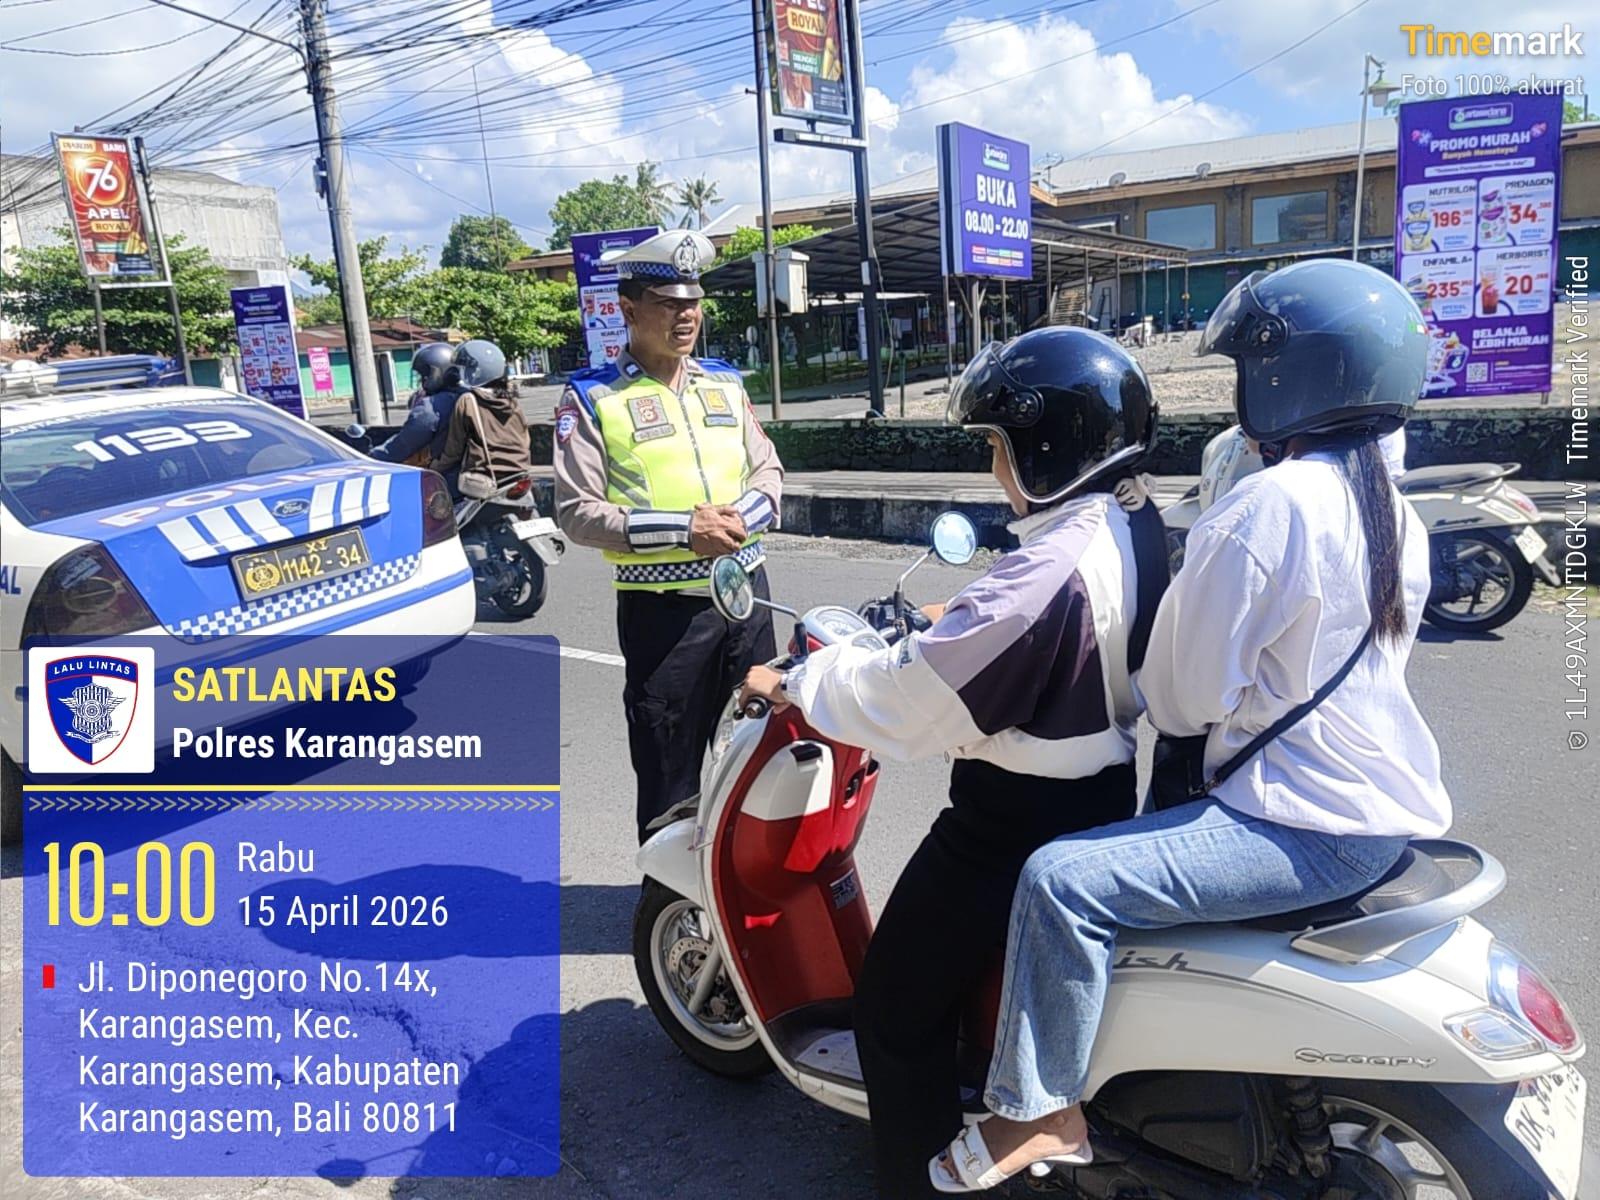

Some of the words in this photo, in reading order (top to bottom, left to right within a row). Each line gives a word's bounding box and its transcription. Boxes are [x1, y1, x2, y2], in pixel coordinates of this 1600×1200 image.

[1430, 137, 1478, 153] PROMO
[1480, 130, 1531, 147] MURAH
[84, 159, 119, 199] 76
[1504, 178, 1554, 190] PRENAGEN
[976, 173, 1017, 208] BUKA
[1429, 185, 1477, 196] NUTRILON
[87, 208, 130, 219] APEL
[1433, 210, 1461, 228] 196
[1509, 203, 1537, 224] 34
[965, 209, 994, 235] 08.00
[1002, 216, 1029, 239] 22.00
[1427, 281, 1460, 298] 235
[1505, 274, 1533, 295] 20
[600, 302, 615, 315] 26
[1472, 326, 1528, 339] BELANJA
[1472, 337, 1506, 349] LEBIH
[1507, 335, 1549, 347] MURAH
[72, 420, 253, 462] 1133
